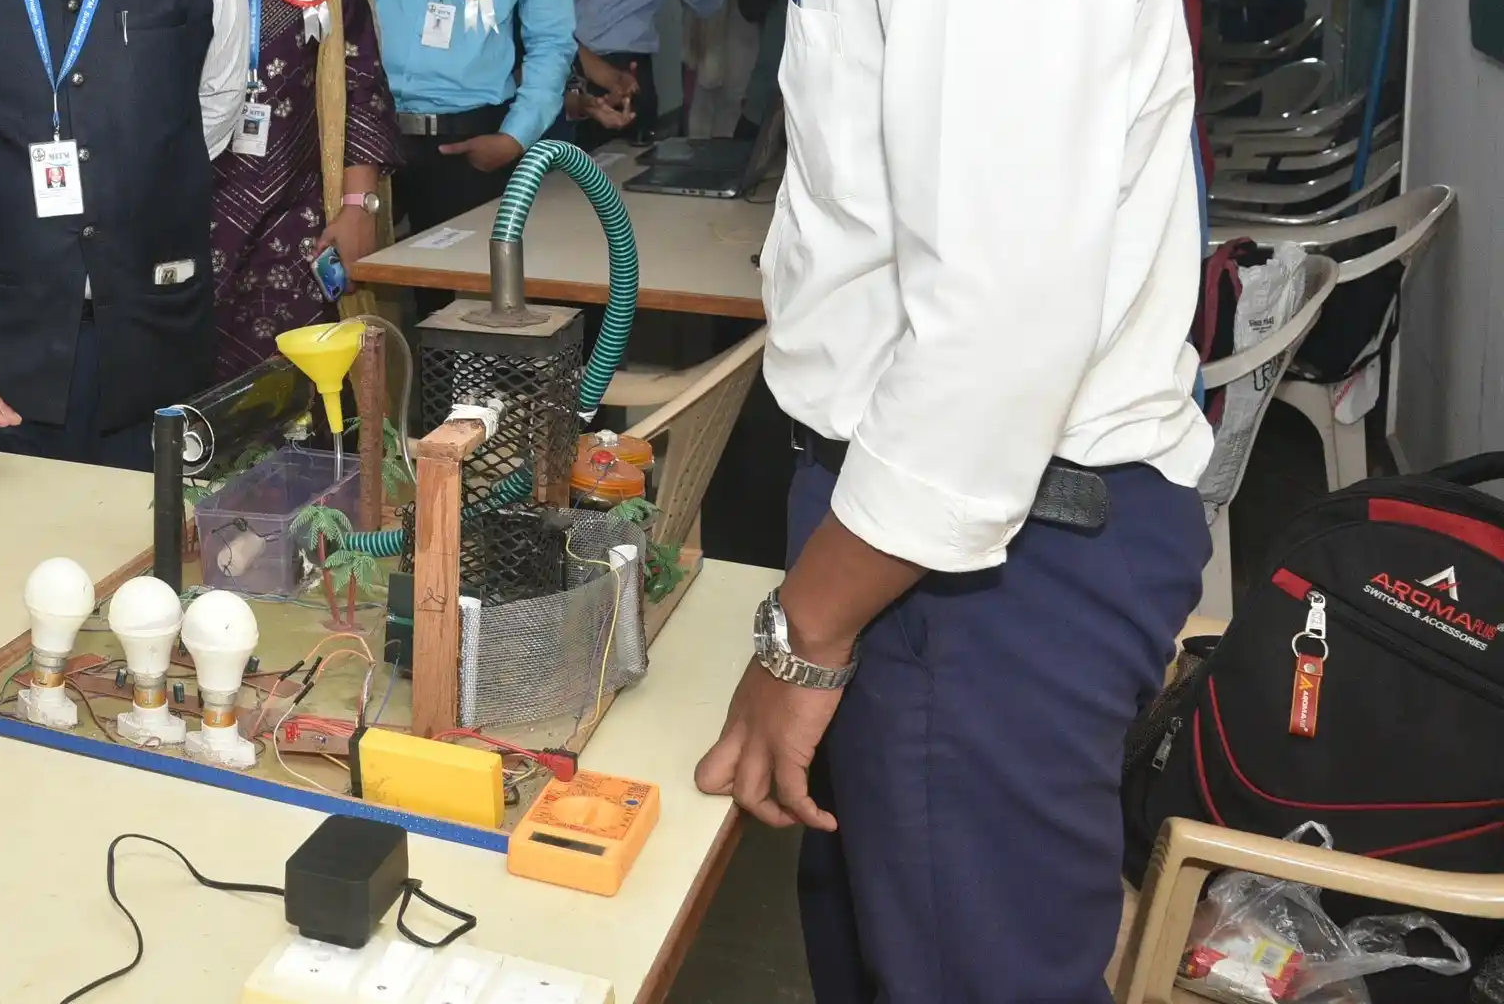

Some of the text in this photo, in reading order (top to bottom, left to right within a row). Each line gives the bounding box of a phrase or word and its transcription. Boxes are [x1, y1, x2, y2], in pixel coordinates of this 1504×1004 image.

[1363, 584, 1488, 651] SWITCHES & ACCESSORIES
